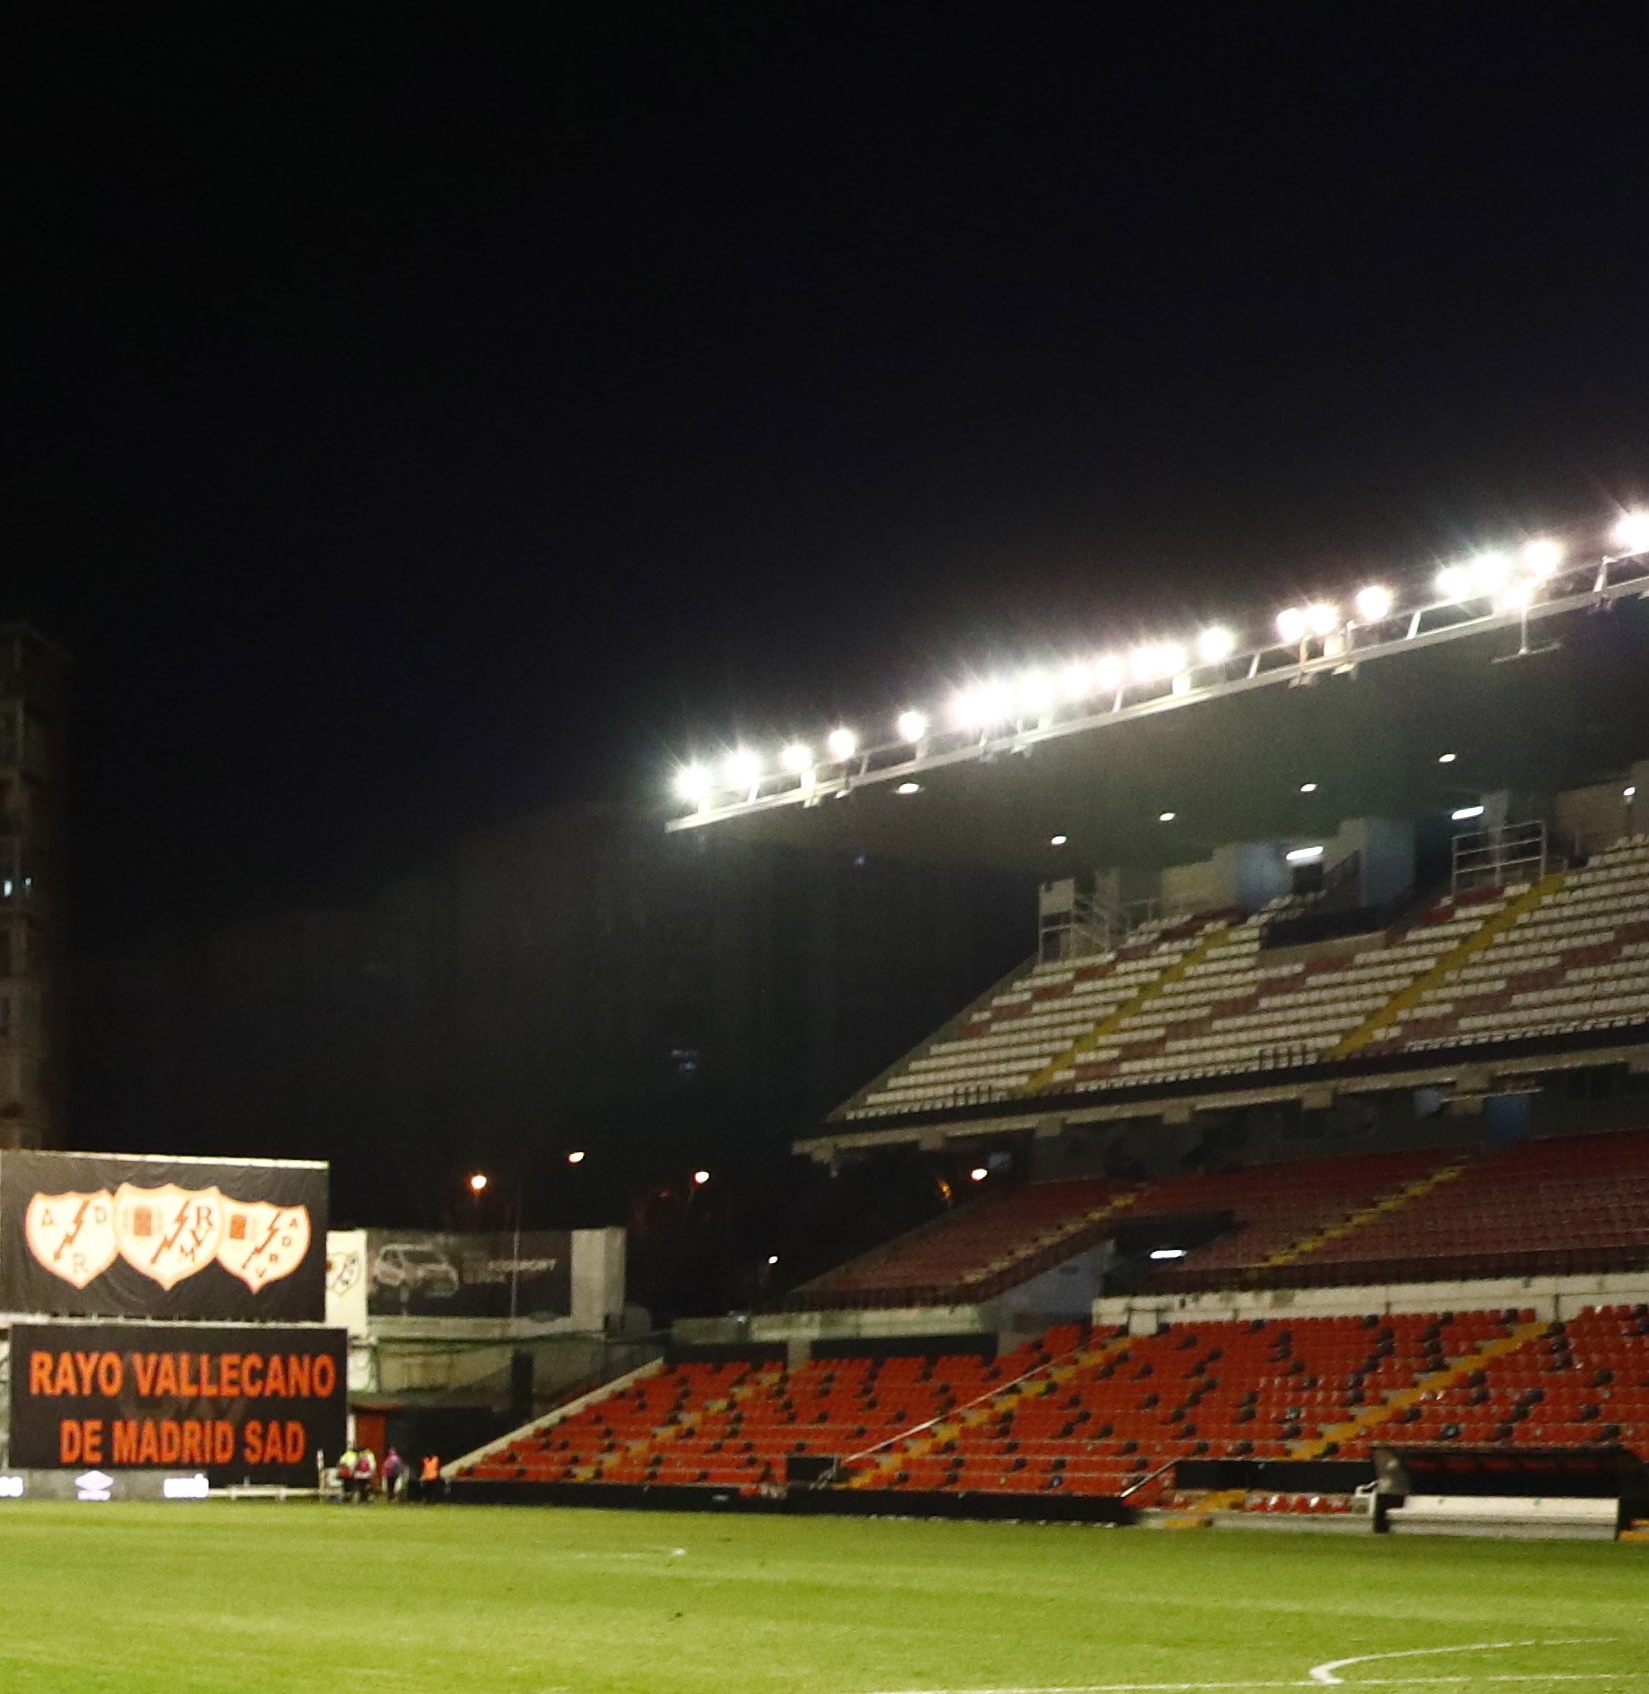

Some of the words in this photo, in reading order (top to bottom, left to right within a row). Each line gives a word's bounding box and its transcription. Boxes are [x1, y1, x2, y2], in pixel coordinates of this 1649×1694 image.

[29, 1351, 124, 1397] RAYO
[132, 1352, 336, 1398] VALLECANO
[60, 1419, 103, 1463] DE
[112, 1419, 234, 1464] MADRID
[244, 1420, 305, 1464] SAD
